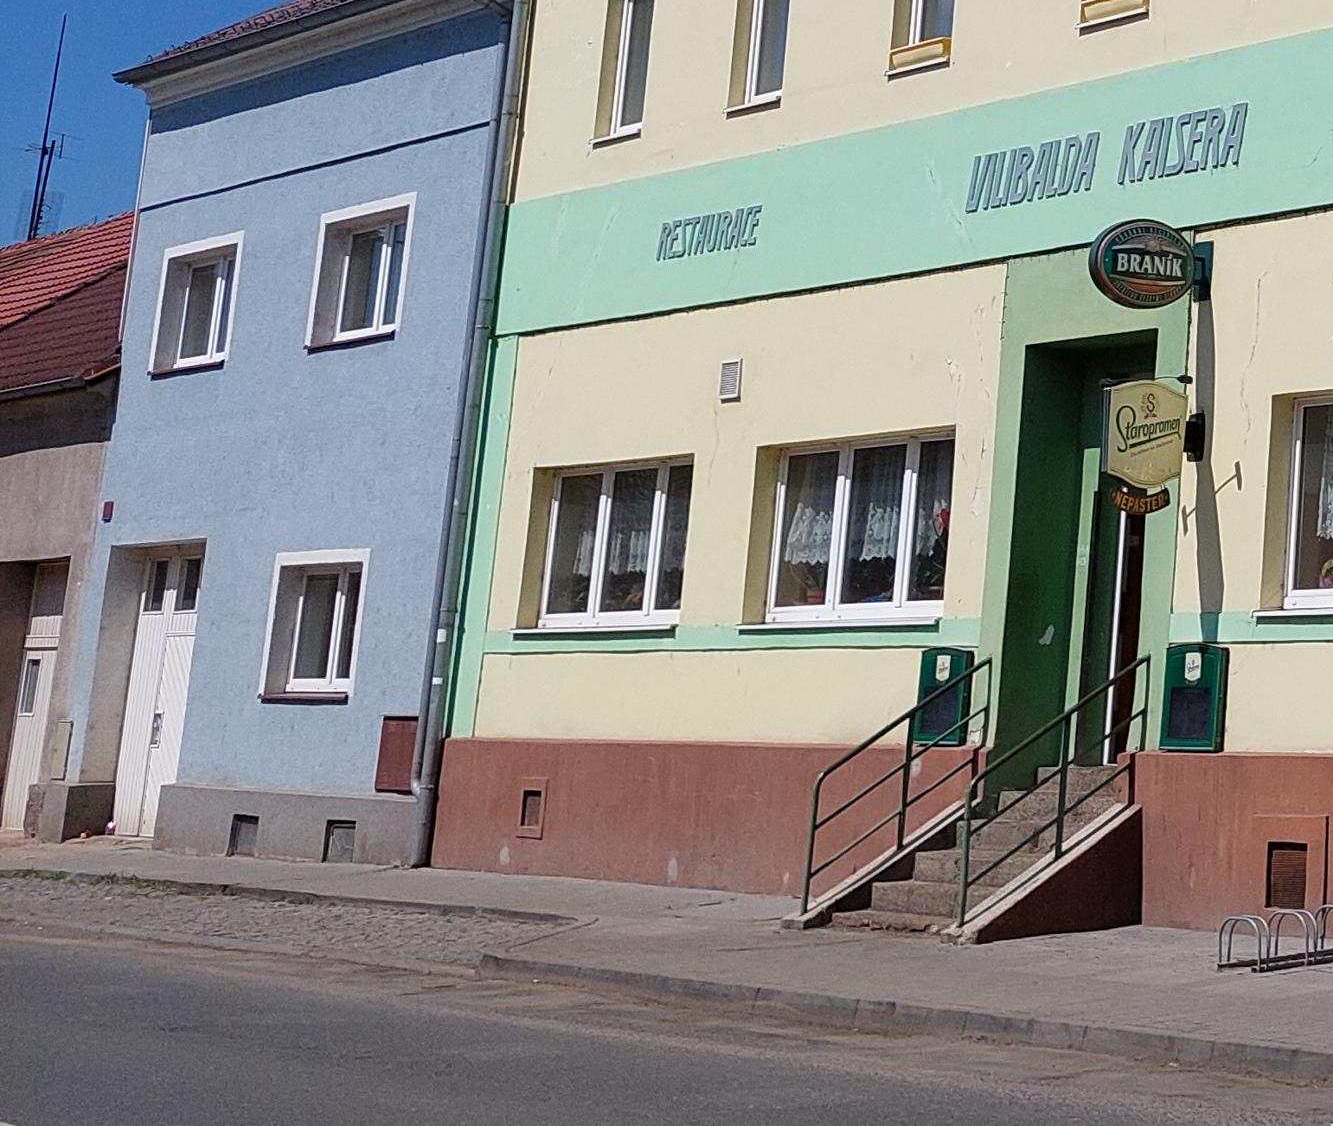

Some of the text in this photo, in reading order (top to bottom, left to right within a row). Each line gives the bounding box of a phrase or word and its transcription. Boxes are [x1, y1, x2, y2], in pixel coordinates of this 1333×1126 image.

[965, 101, 1249, 214] VILIBALDA KAISERA
[655, 204, 763, 262] RESTAURACE
[1116, 253, 1183, 277] BRANÍK
[1115, 404, 1181, 454] Staropramen
